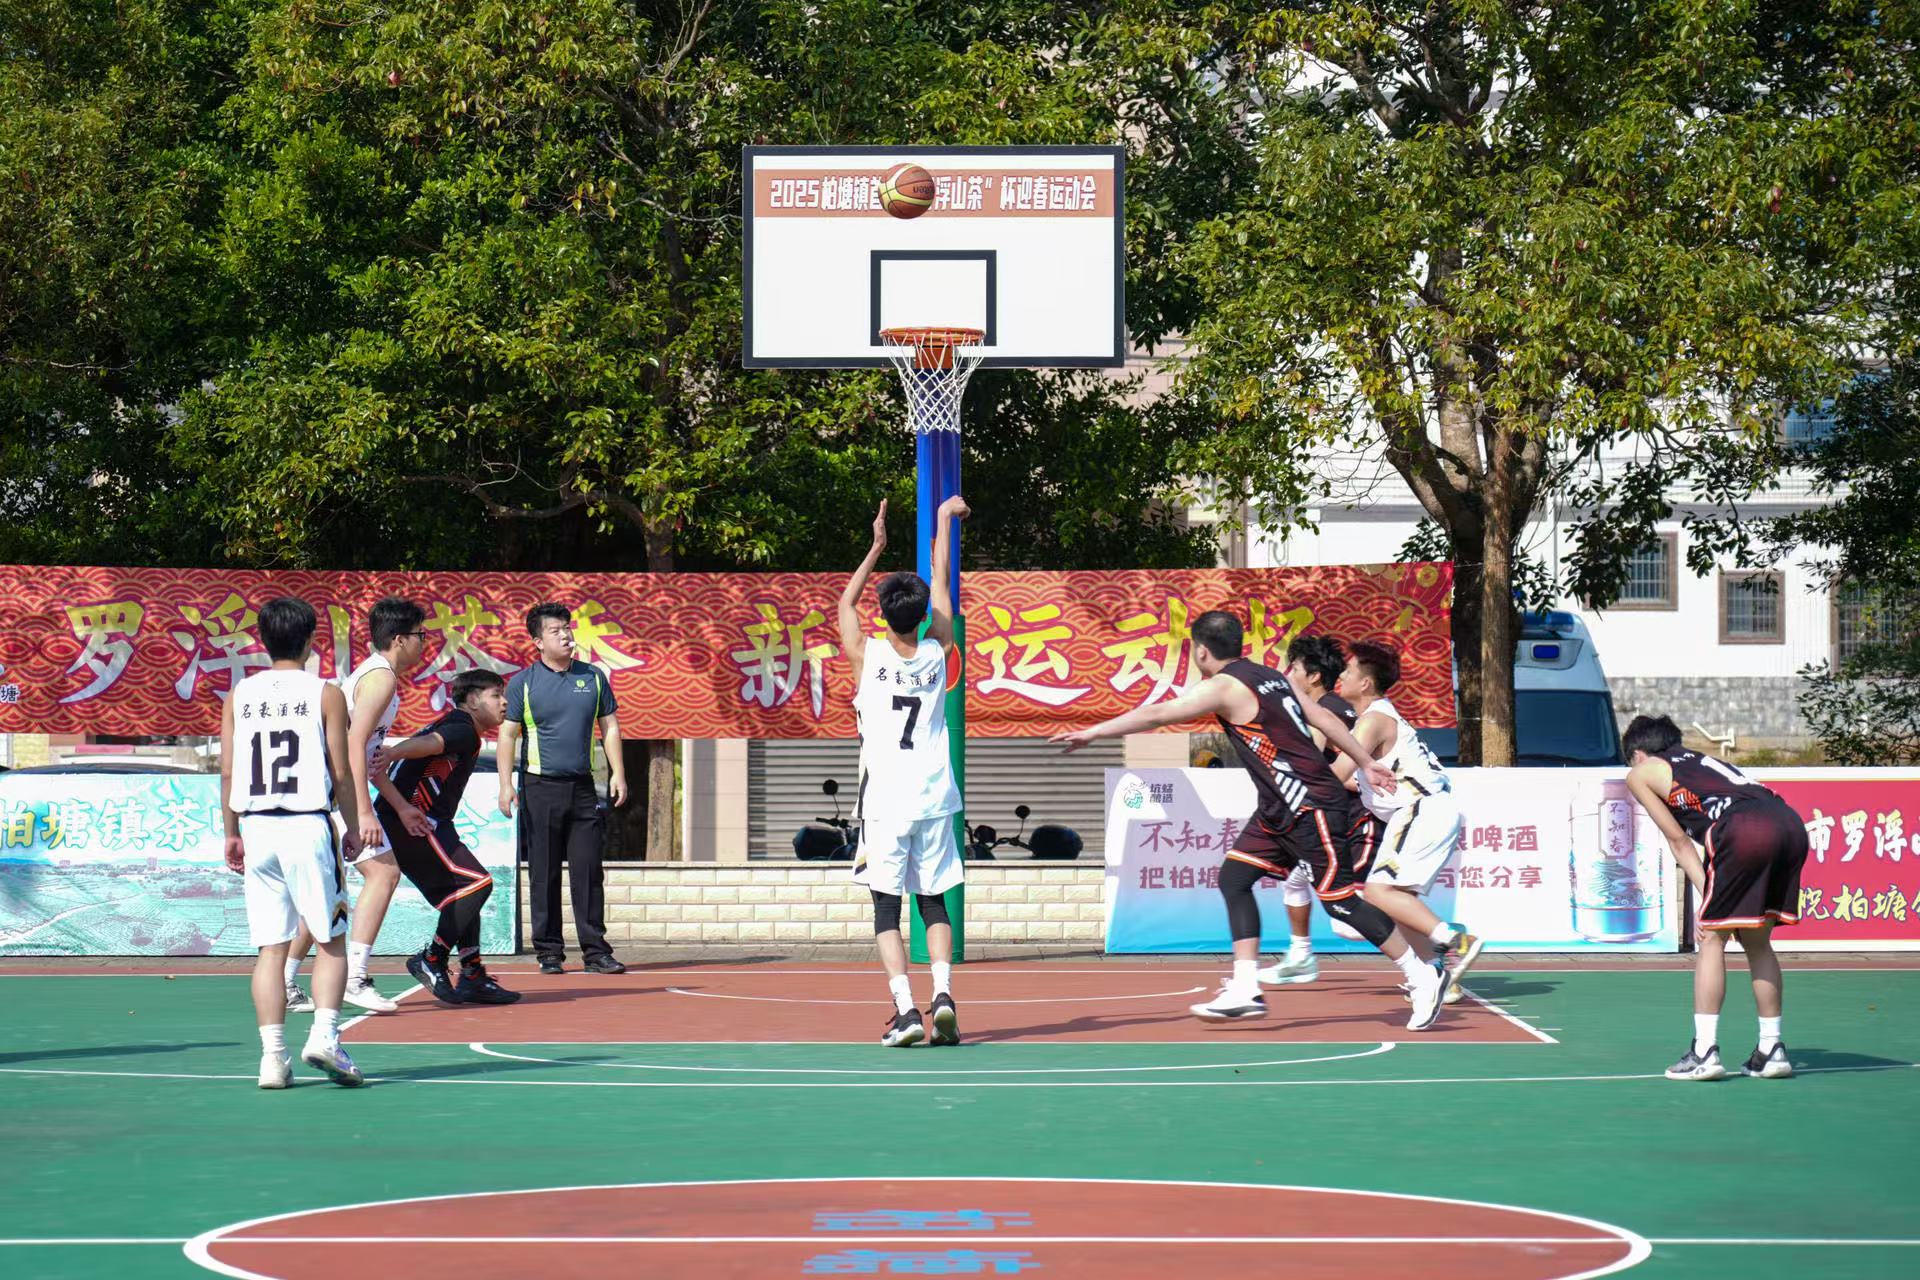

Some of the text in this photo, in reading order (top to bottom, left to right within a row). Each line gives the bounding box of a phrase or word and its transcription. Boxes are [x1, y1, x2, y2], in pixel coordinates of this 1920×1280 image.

[892, 695, 922, 750] 7
[250, 729, 299, 796] 12
[1804, 808, 1920, 863] 市罗浮
[1798, 884, 1920, 922] 院柏塘
